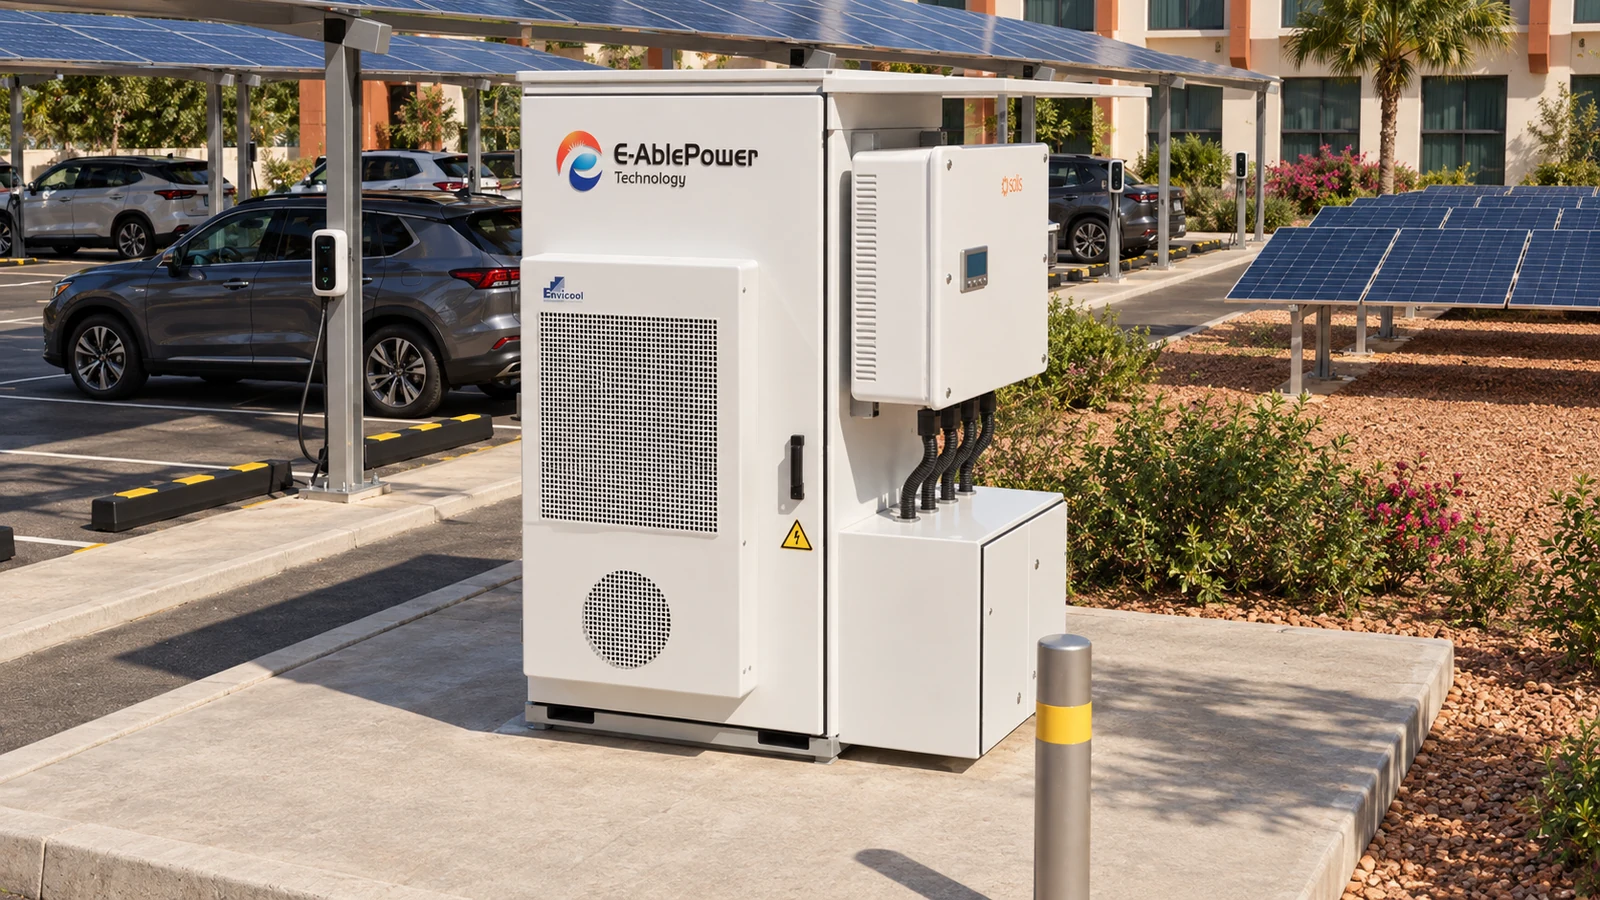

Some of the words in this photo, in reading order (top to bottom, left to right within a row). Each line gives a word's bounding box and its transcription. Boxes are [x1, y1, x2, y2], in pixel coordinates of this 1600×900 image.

[613, 143, 759, 167] E-AblePower
[614, 171, 686, 188] Technology
[543, 287, 584, 300] Envicool
